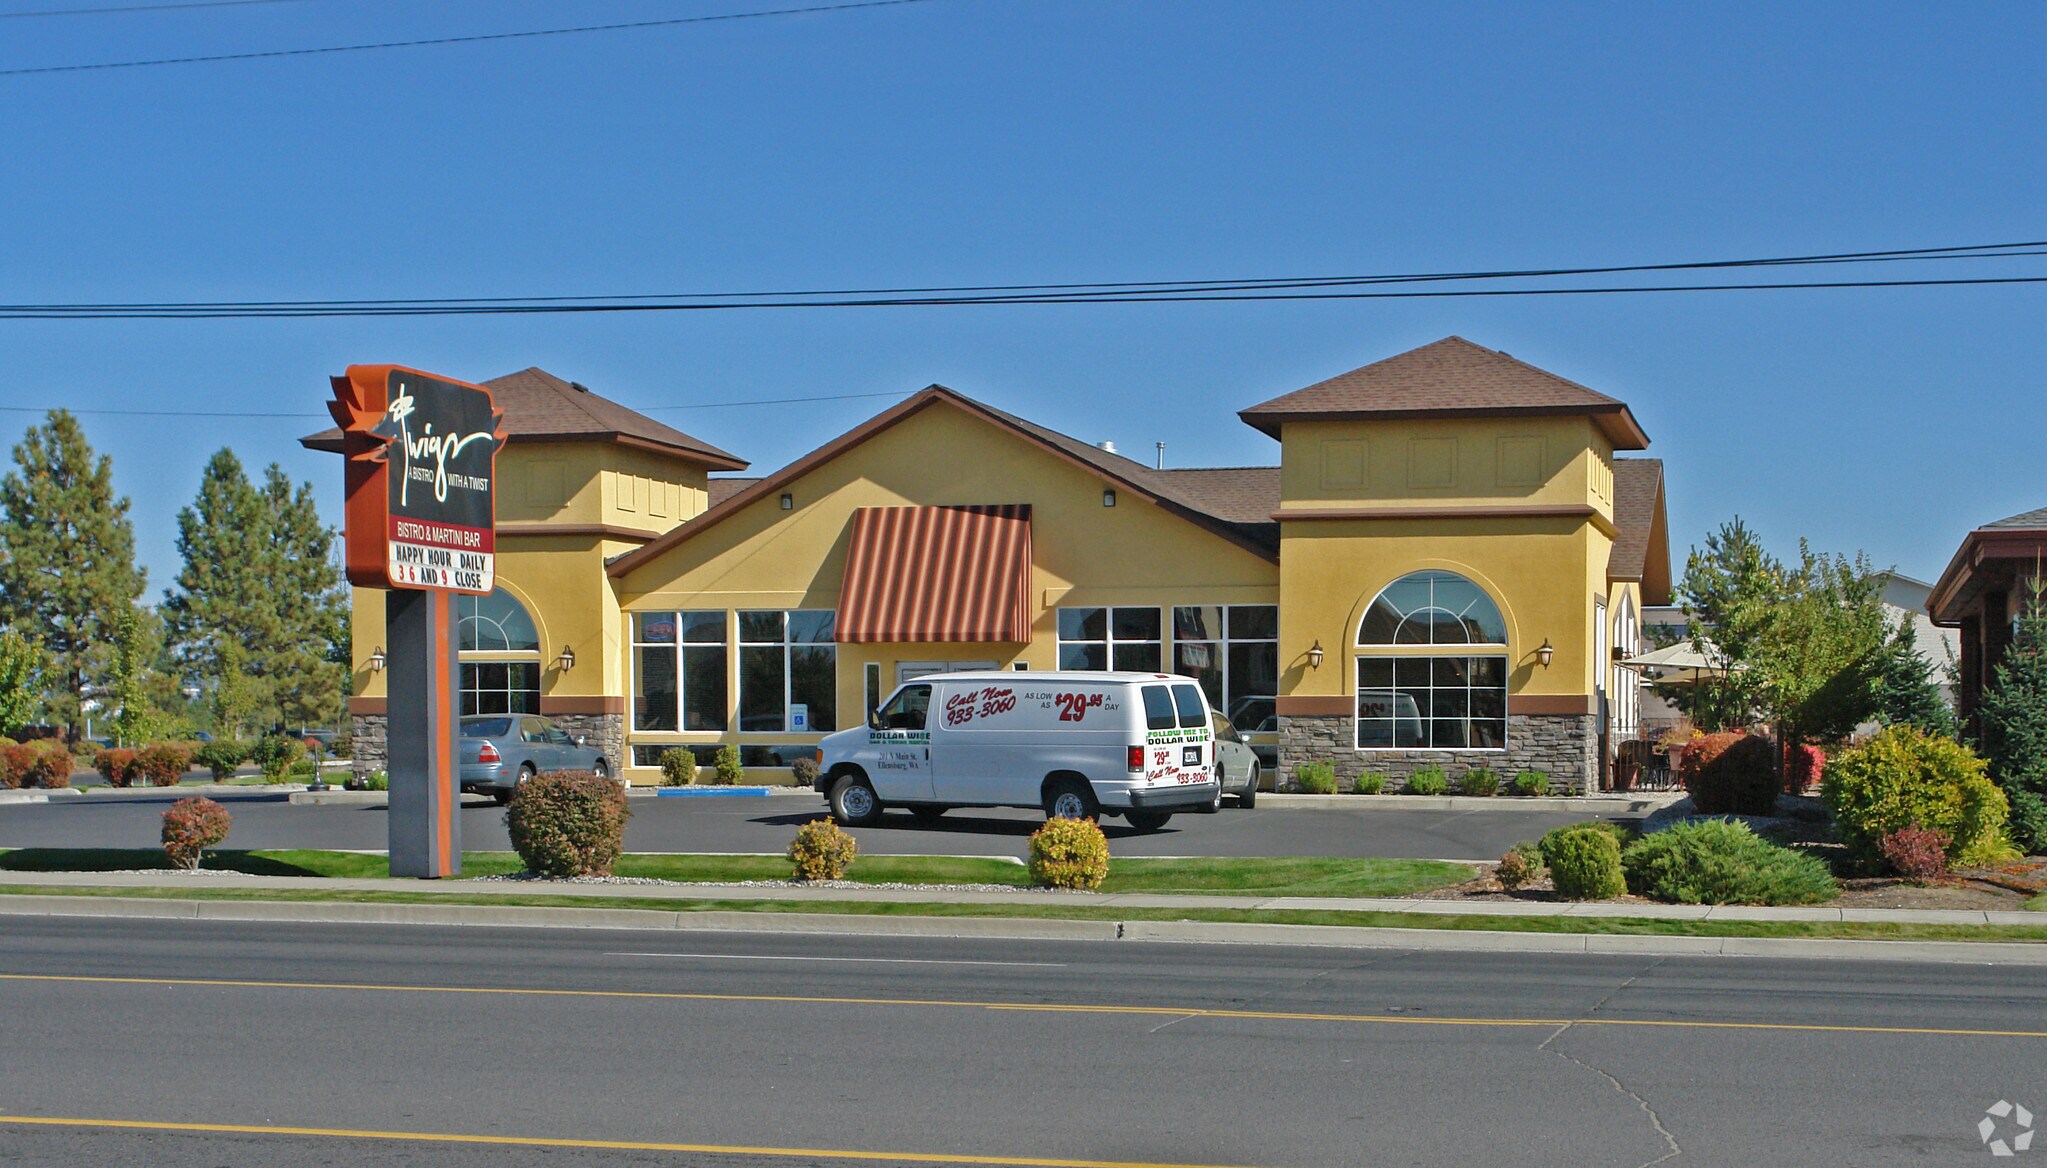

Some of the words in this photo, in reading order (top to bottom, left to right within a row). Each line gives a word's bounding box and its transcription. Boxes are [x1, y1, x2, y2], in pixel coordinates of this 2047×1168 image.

[408, 466, 413, 479] A
[412, 467, 434, 483] BISTRO
[447, 473, 463, 488] WITH
[463, 475, 469, 489] A
[468, 476, 489, 492] TWIST
[397, 521, 425, 541] BISTRO
[425, 525, 432, 541] &
[432, 526, 463, 546] MARTINI
[464, 531, 481, 548] BAR
[396, 544, 424, 564] HAPPY
[427, 549, 453, 568] HOUR
[460, 552, 486, 571] DAILY
[399, 564, 405, 580] 3
[409, 566, 415, 582] 6
[420, 567, 438, 584] AND
[441, 569, 448, 585] 9
[455, 571, 482, 590] CLOSE
[946, 691, 979, 710] Call
[980, 687, 1013, 700] Now
[1104, 703, 1119, 711] DAY
[947, 695, 1016, 726] 933-3060
[870, 732, 904, 740] DOLLAR
[1147, 730, 1181, 738] FOLLOW
[1148, 736, 1184, 745] DOLLAR
[1154, 751, 1169, 765] $29.
[1148, 769, 1164, 782] Call
[1164, 765, 1179, 776] Now
[1176, 772, 1208, 784] 933-3060
